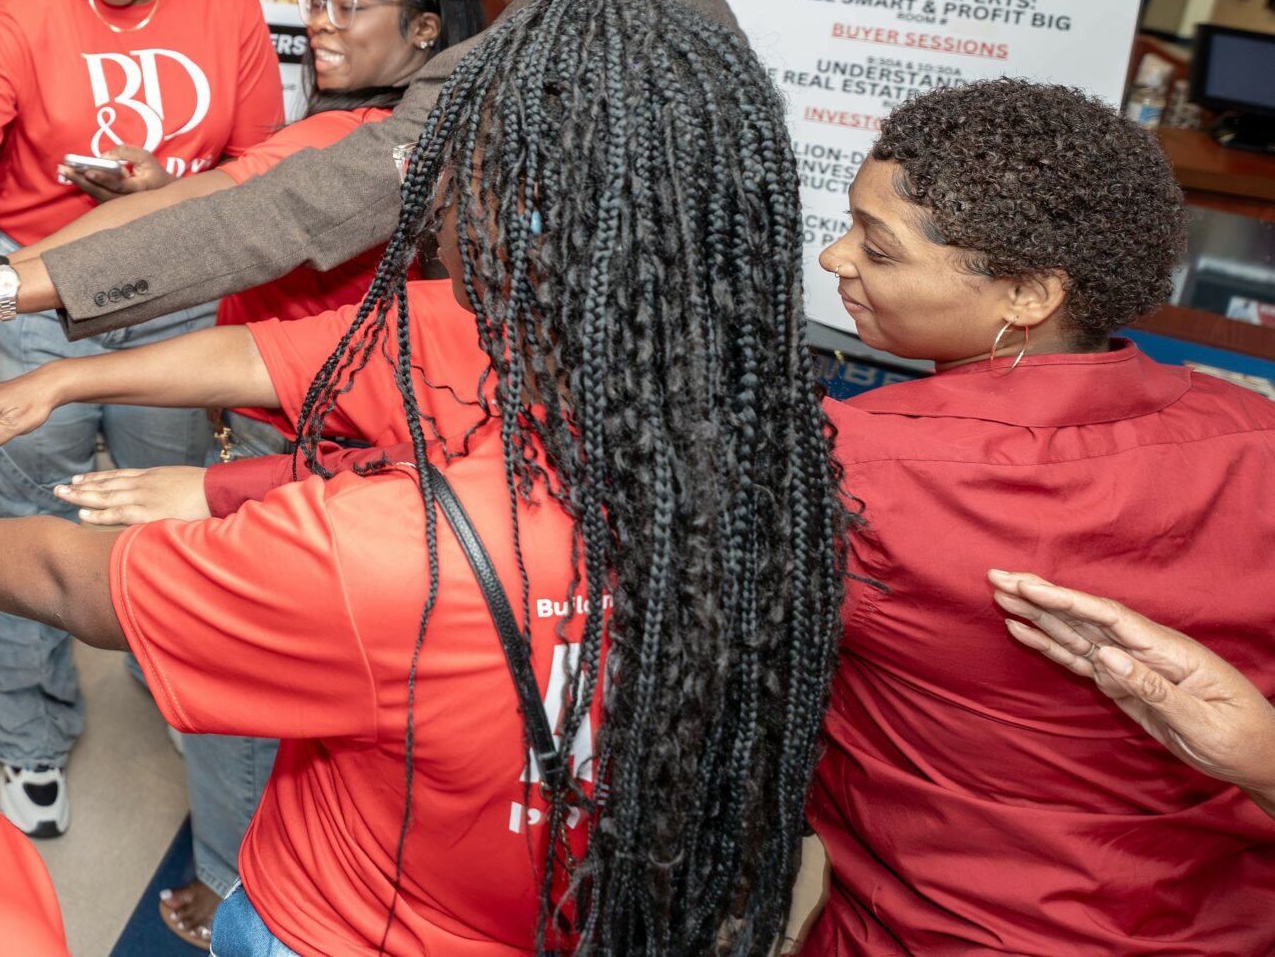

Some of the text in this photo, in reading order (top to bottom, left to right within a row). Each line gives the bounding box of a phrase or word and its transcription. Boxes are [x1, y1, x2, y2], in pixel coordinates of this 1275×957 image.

[922, 0, 936, 14] &
[943, 2, 1026, 25] PROFIT
[1031, 12, 1072, 31] BIG
[832, 22, 1009, 60] BUYER SESSIONS
[783, 70, 834, 90] REAL
[817, 59, 967, 88] UNDERSTAND
